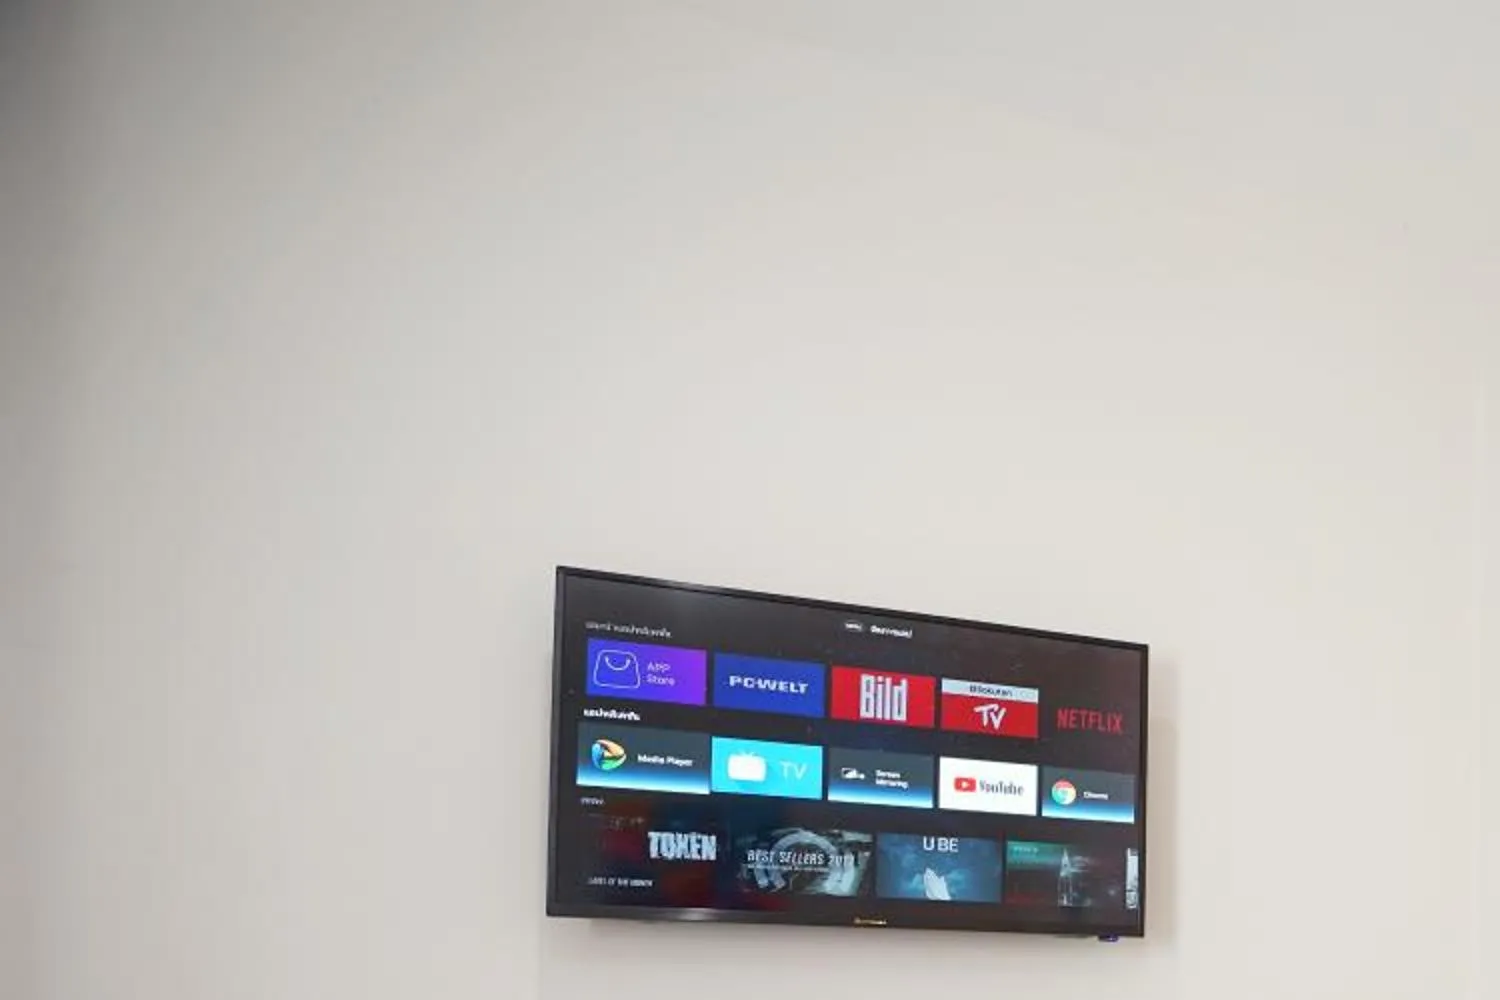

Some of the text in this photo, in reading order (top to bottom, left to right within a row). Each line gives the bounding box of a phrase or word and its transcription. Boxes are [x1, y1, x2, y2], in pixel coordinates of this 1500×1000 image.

[859, 673, 907, 721] Bild
[1056, 708, 1123, 734] NETFLIX
[780, 761, 807, 779] TV
[979, 779, 1024, 796] YouTube
